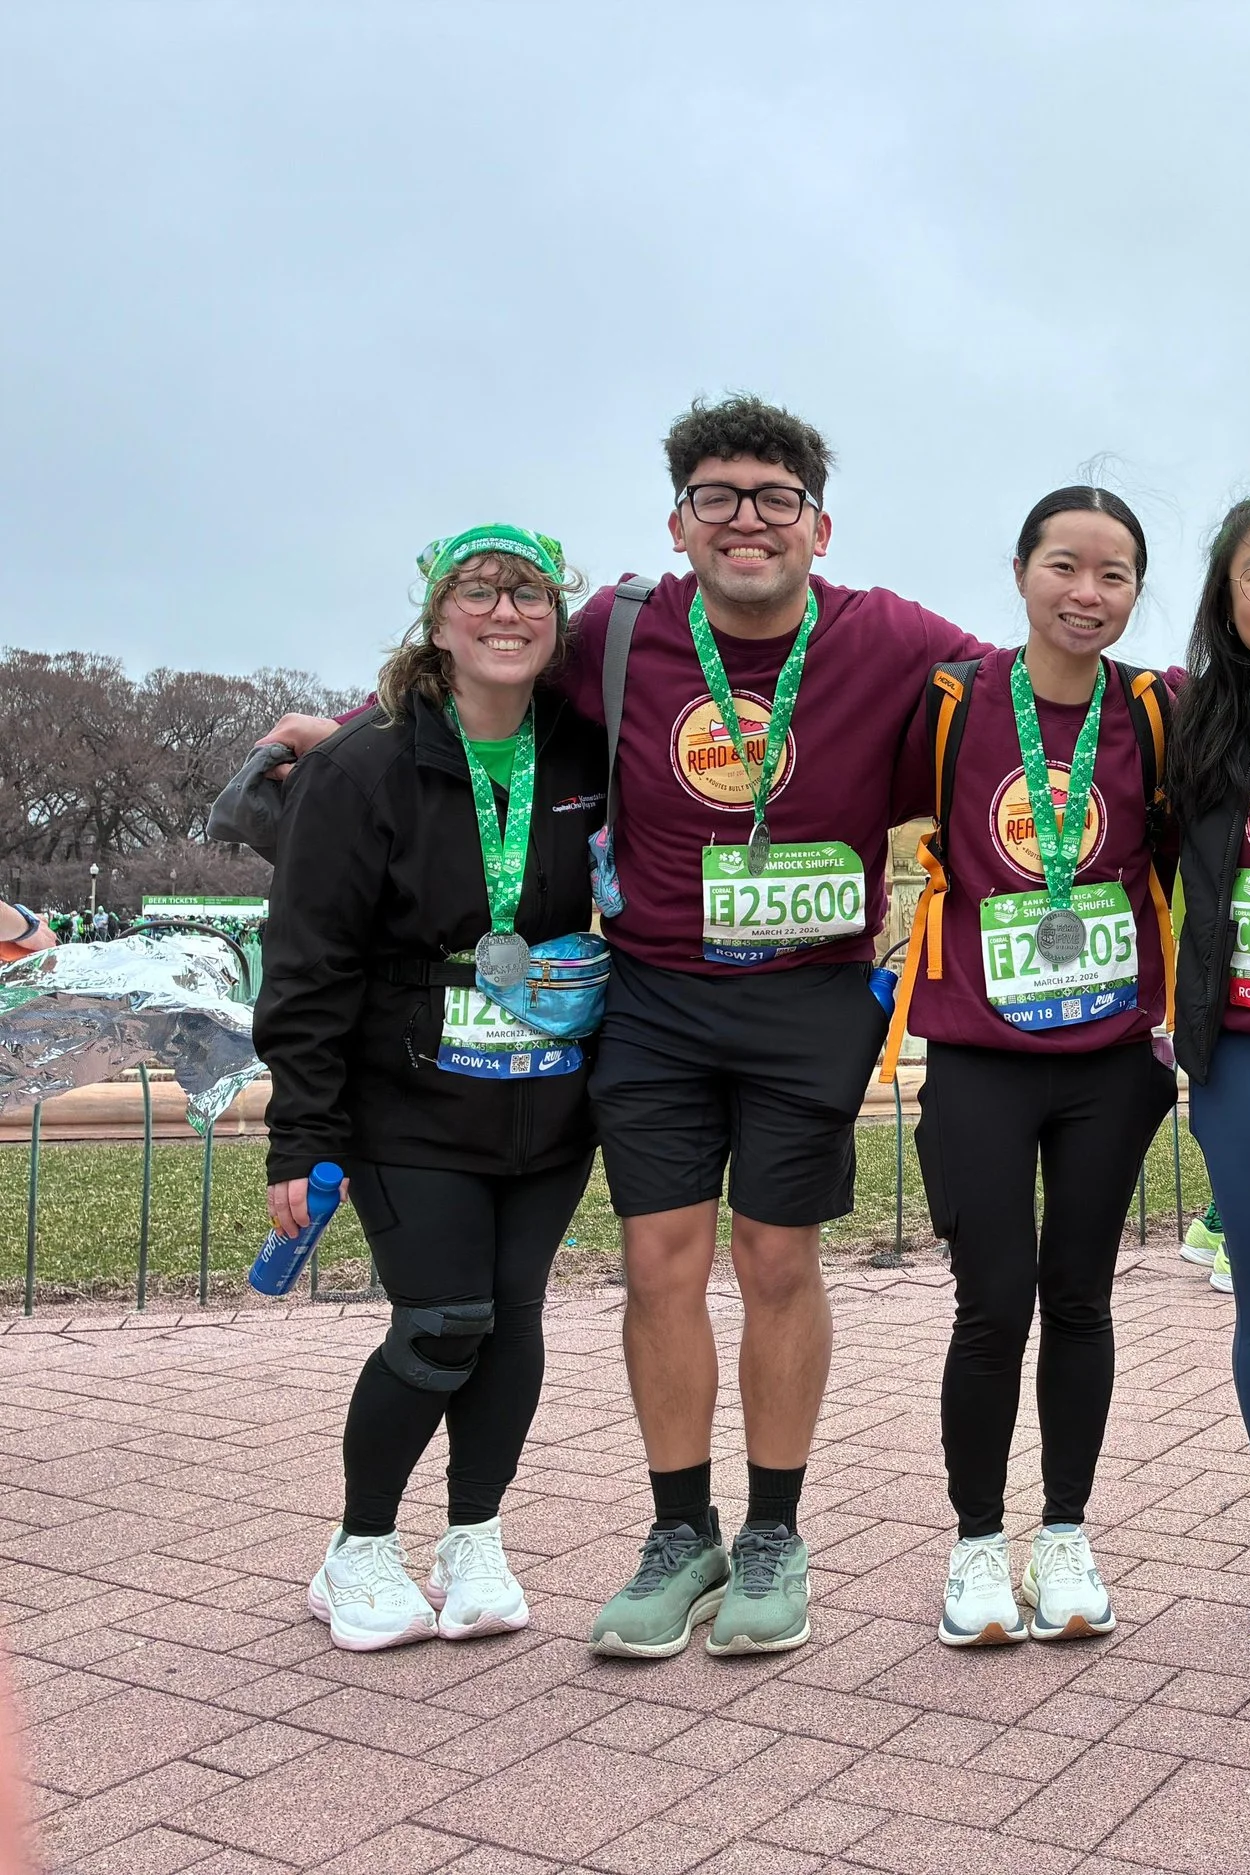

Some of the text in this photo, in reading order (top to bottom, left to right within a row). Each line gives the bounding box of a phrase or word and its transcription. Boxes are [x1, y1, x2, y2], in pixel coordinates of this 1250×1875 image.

[688, 738, 766, 776] READ & RU
[1006, 817, 1038, 845] REA
[764, 858, 844, 870] AMROCK SHUFFLE
[739, 880, 860, 926] 25600
[1023, 904, 1076, 918] SHAMK
[1078, 898, 1116, 911] SHUFFLE
[1238, 916, 1250, 952] C
[715, 948, 764, 960] ROW 21
[1015, 920, 1132, 976] 205
[994, 944, 1008, 978] F
[1034, 972, 1099, 988] MARCH 22, 2026
[1026, 993, 1036, 1002] 45
[1096, 992, 1115, 1006] RUN
[1003, 1008, 1053, 1024] ROW 18
[486, 1030, 516, 1038] MARCH
[451, 1054, 500, 1070] ROW 24
[544, 1050, 563, 1062] RUN
